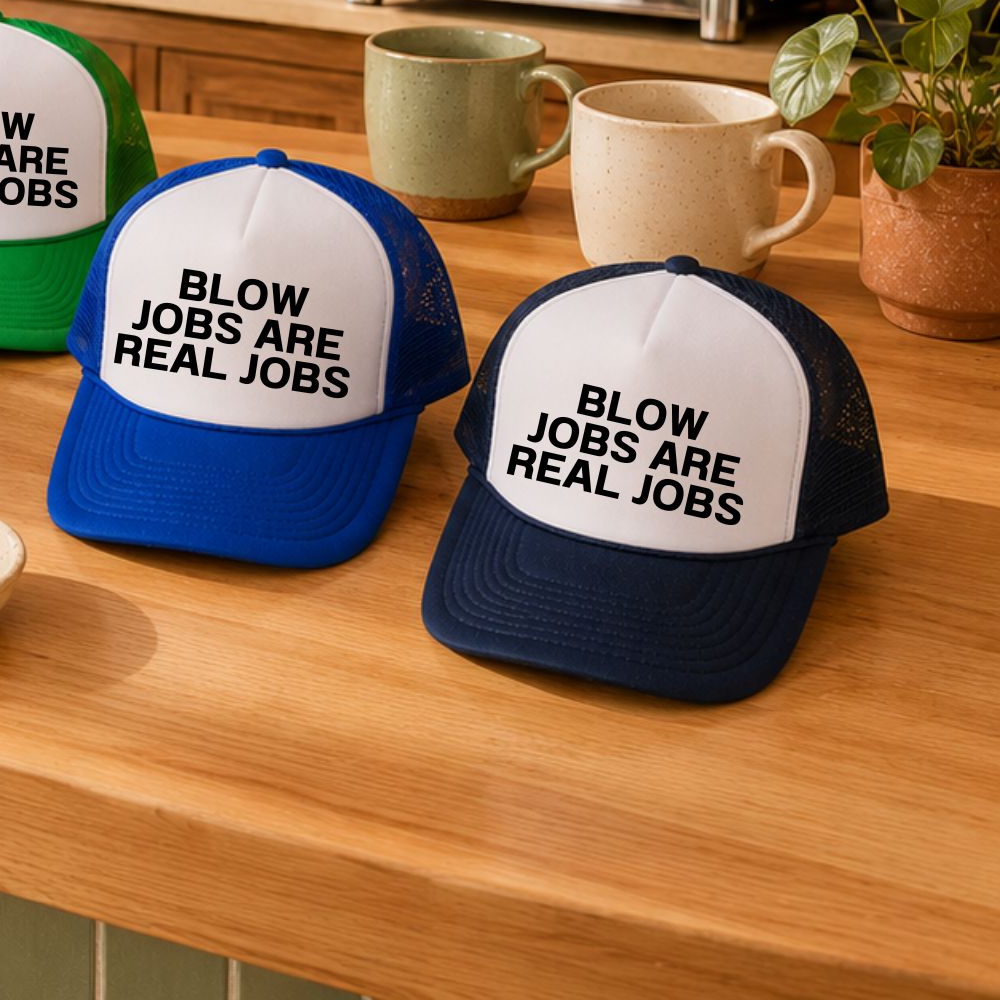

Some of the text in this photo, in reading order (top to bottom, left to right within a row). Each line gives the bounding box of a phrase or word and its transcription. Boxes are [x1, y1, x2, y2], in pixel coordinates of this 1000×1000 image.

[178, 268, 310, 318] BLOW
[131, 299, 345, 362] JOBS ARE
[113, 332, 351, 399] REAL JOBS
[576, 383, 710, 441] BLOW
[526, 412, 741, 488] JOBS ARE
[506, 443, 744, 526] REAL JOBS
